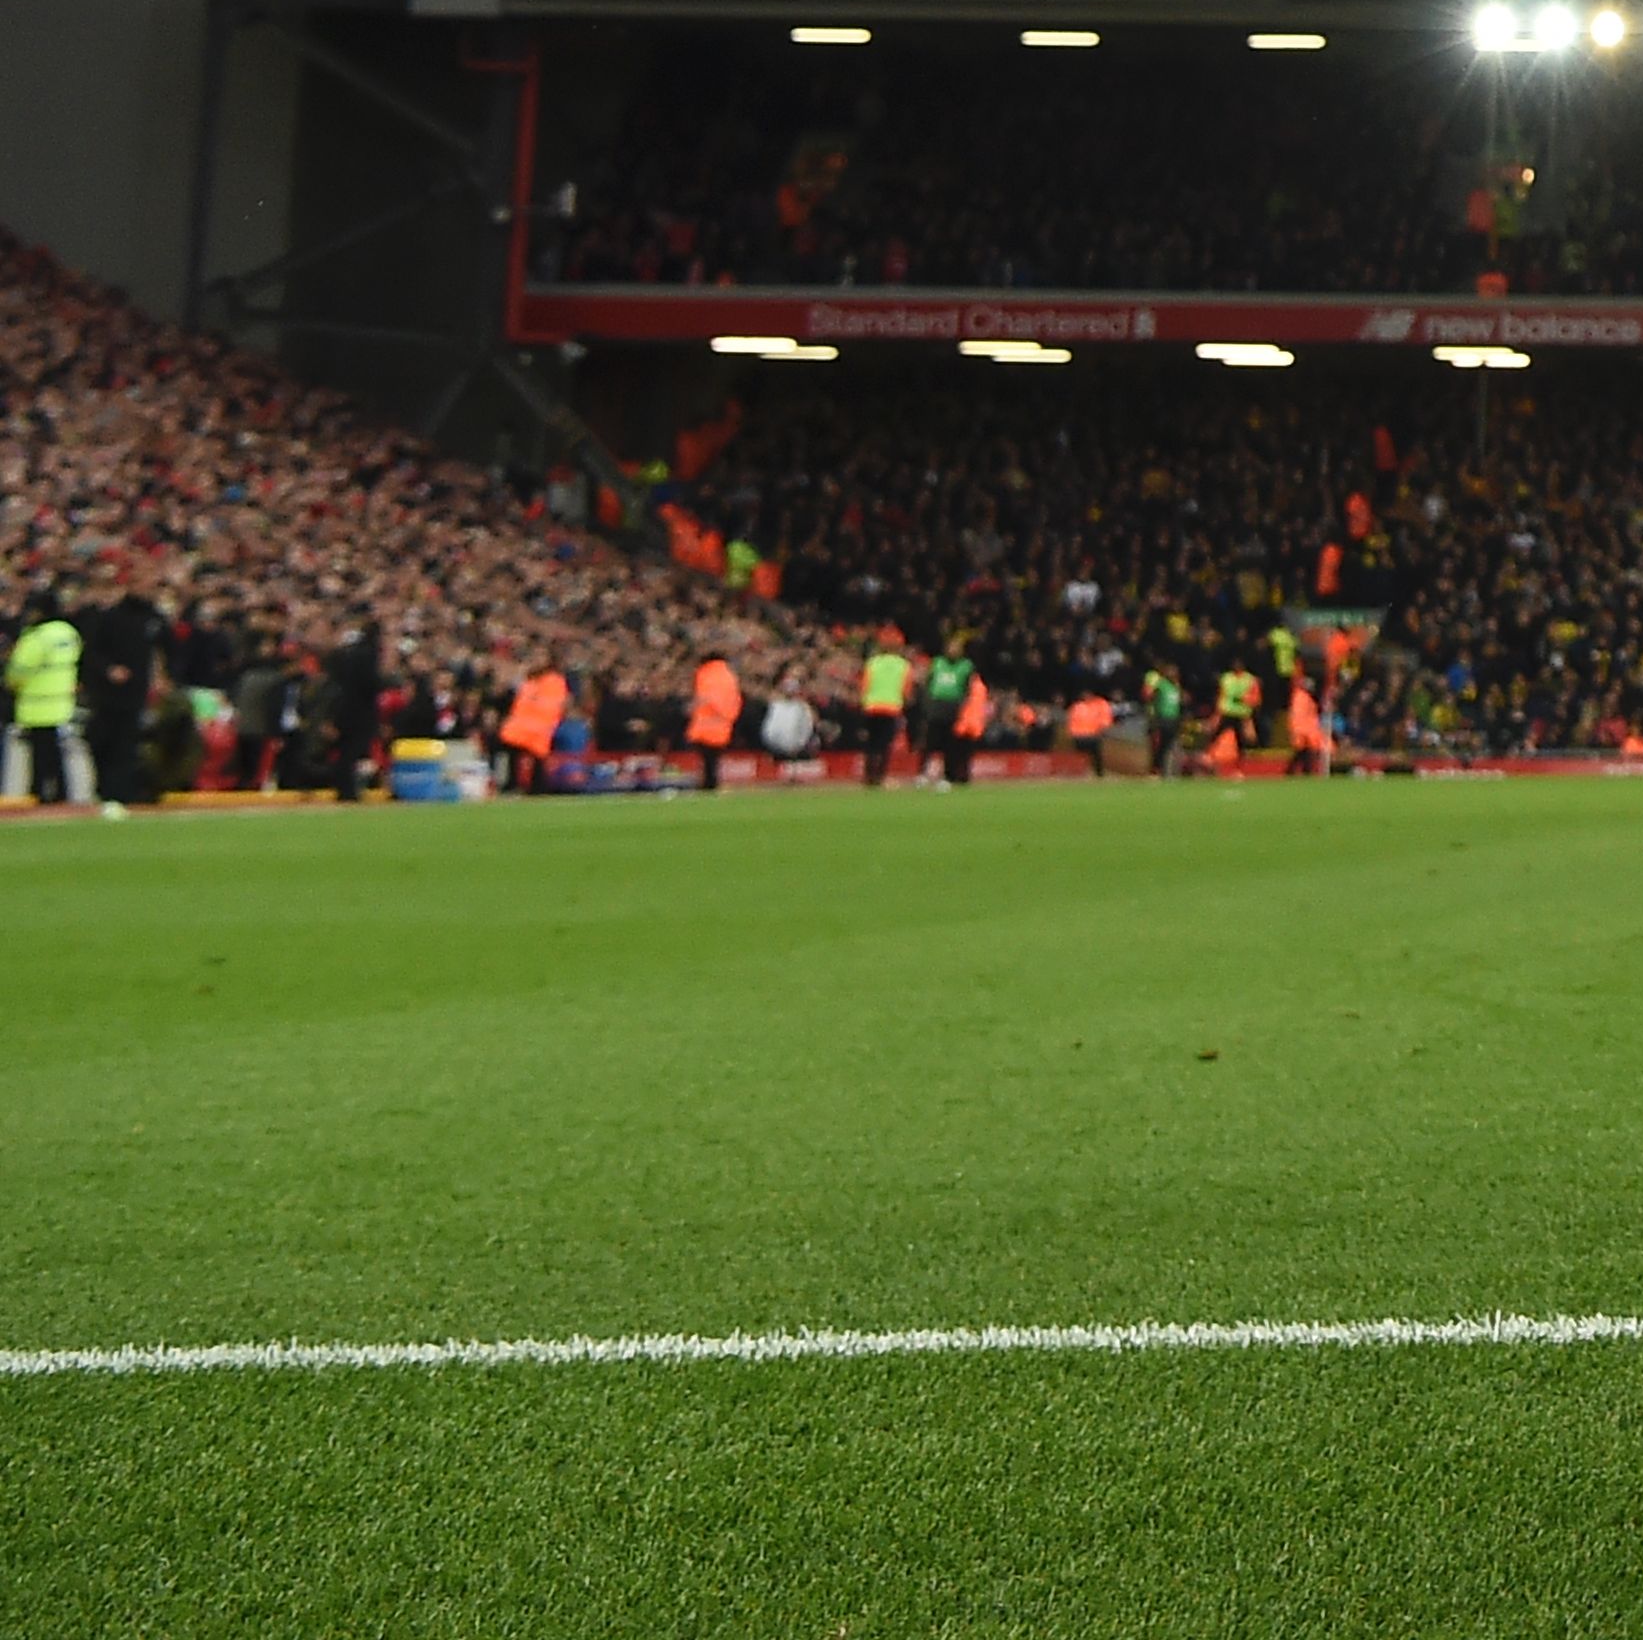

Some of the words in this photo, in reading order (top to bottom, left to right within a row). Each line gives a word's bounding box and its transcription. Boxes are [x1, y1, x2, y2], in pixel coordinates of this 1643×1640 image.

[810, 305, 958, 337] Standard
[965, 305, 1129, 339] Chartered
[1503, 311, 1641, 341] balance
